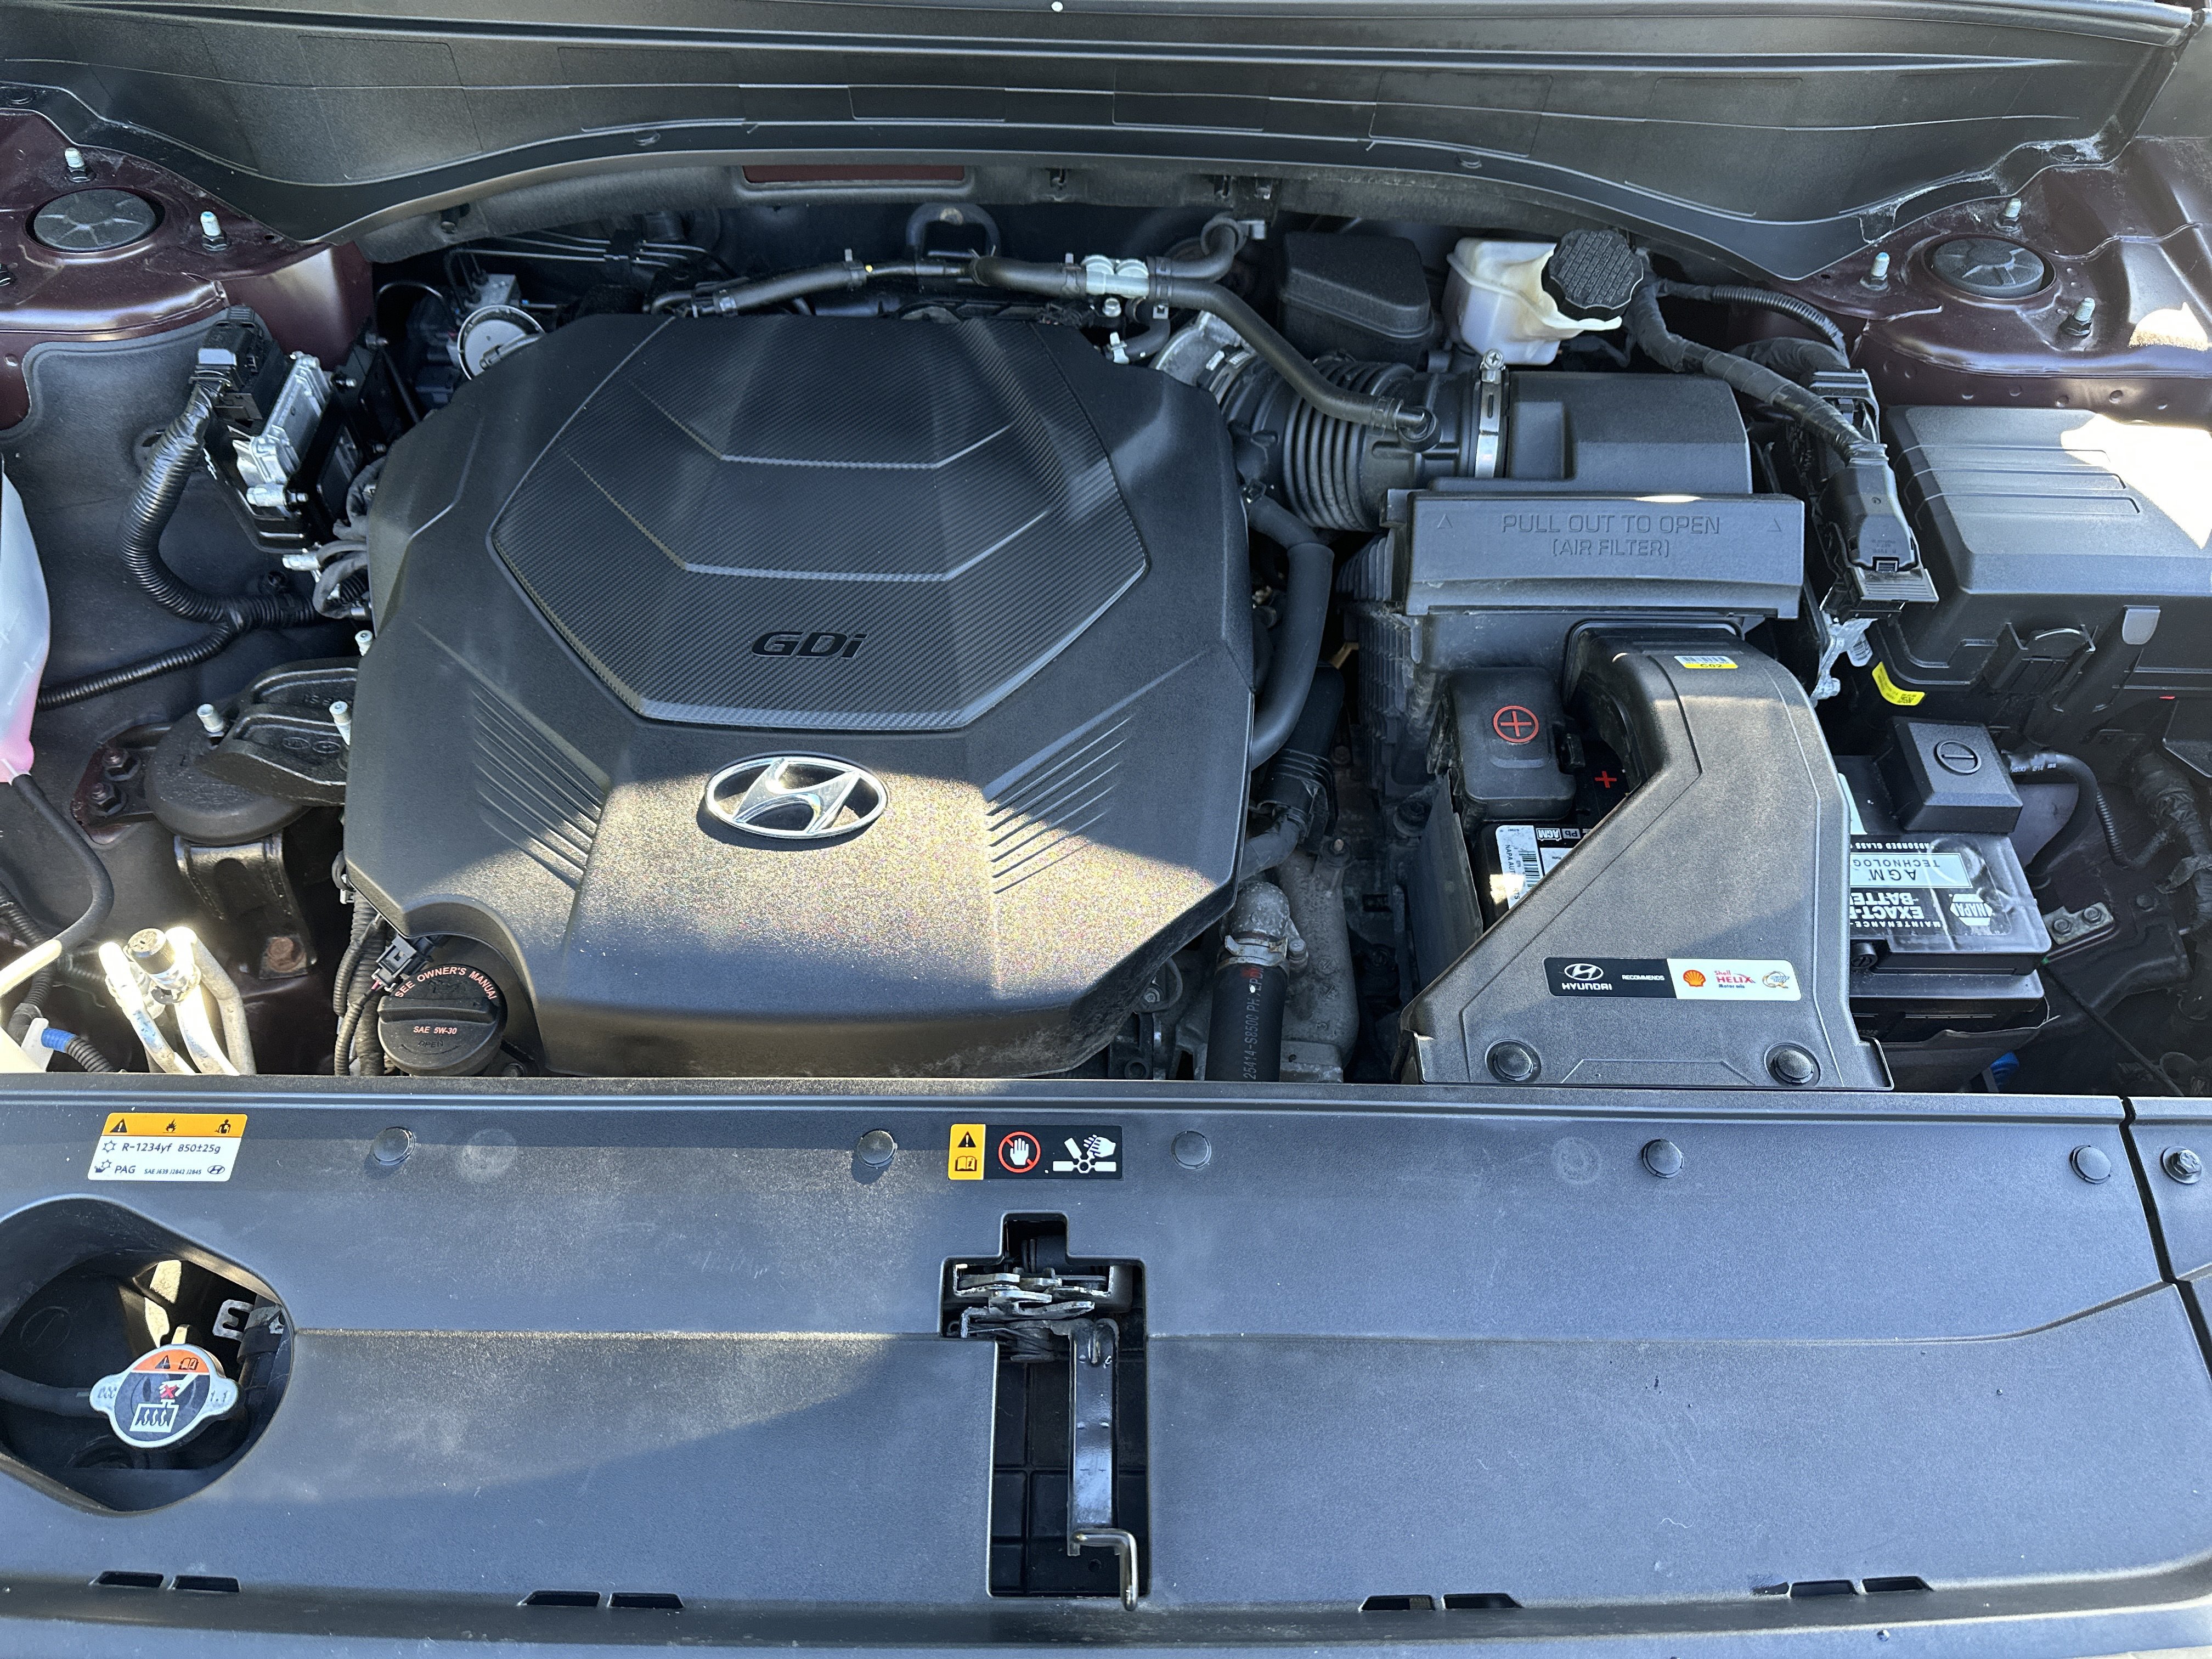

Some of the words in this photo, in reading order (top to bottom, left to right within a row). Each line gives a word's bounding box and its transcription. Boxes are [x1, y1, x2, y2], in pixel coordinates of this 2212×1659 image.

[1502, 514, 1560, 533] PULL
[1567, 515, 1615, 533] OUT
[1621, 515, 1651, 534] TO
[1660, 516, 1720, 534] OPEN
[752, 631, 869, 658] GDi
[1538, 830, 1559, 838] AGM
[1505, 844, 1513, 861] NAPA
[1870, 869, 1917, 881] AGM
[1850, 892, 1914, 906] BATTE
[1956, 902, 1987, 917] NAPA
[394, 981, 415, 997] SEE
[417, 967, 466, 982] OWNER'S
[121, 1143, 173, 1154] R-1234yf
[177, 1144, 221, 1154] 850±25g
[114, 1165, 136, 1174] PAG
